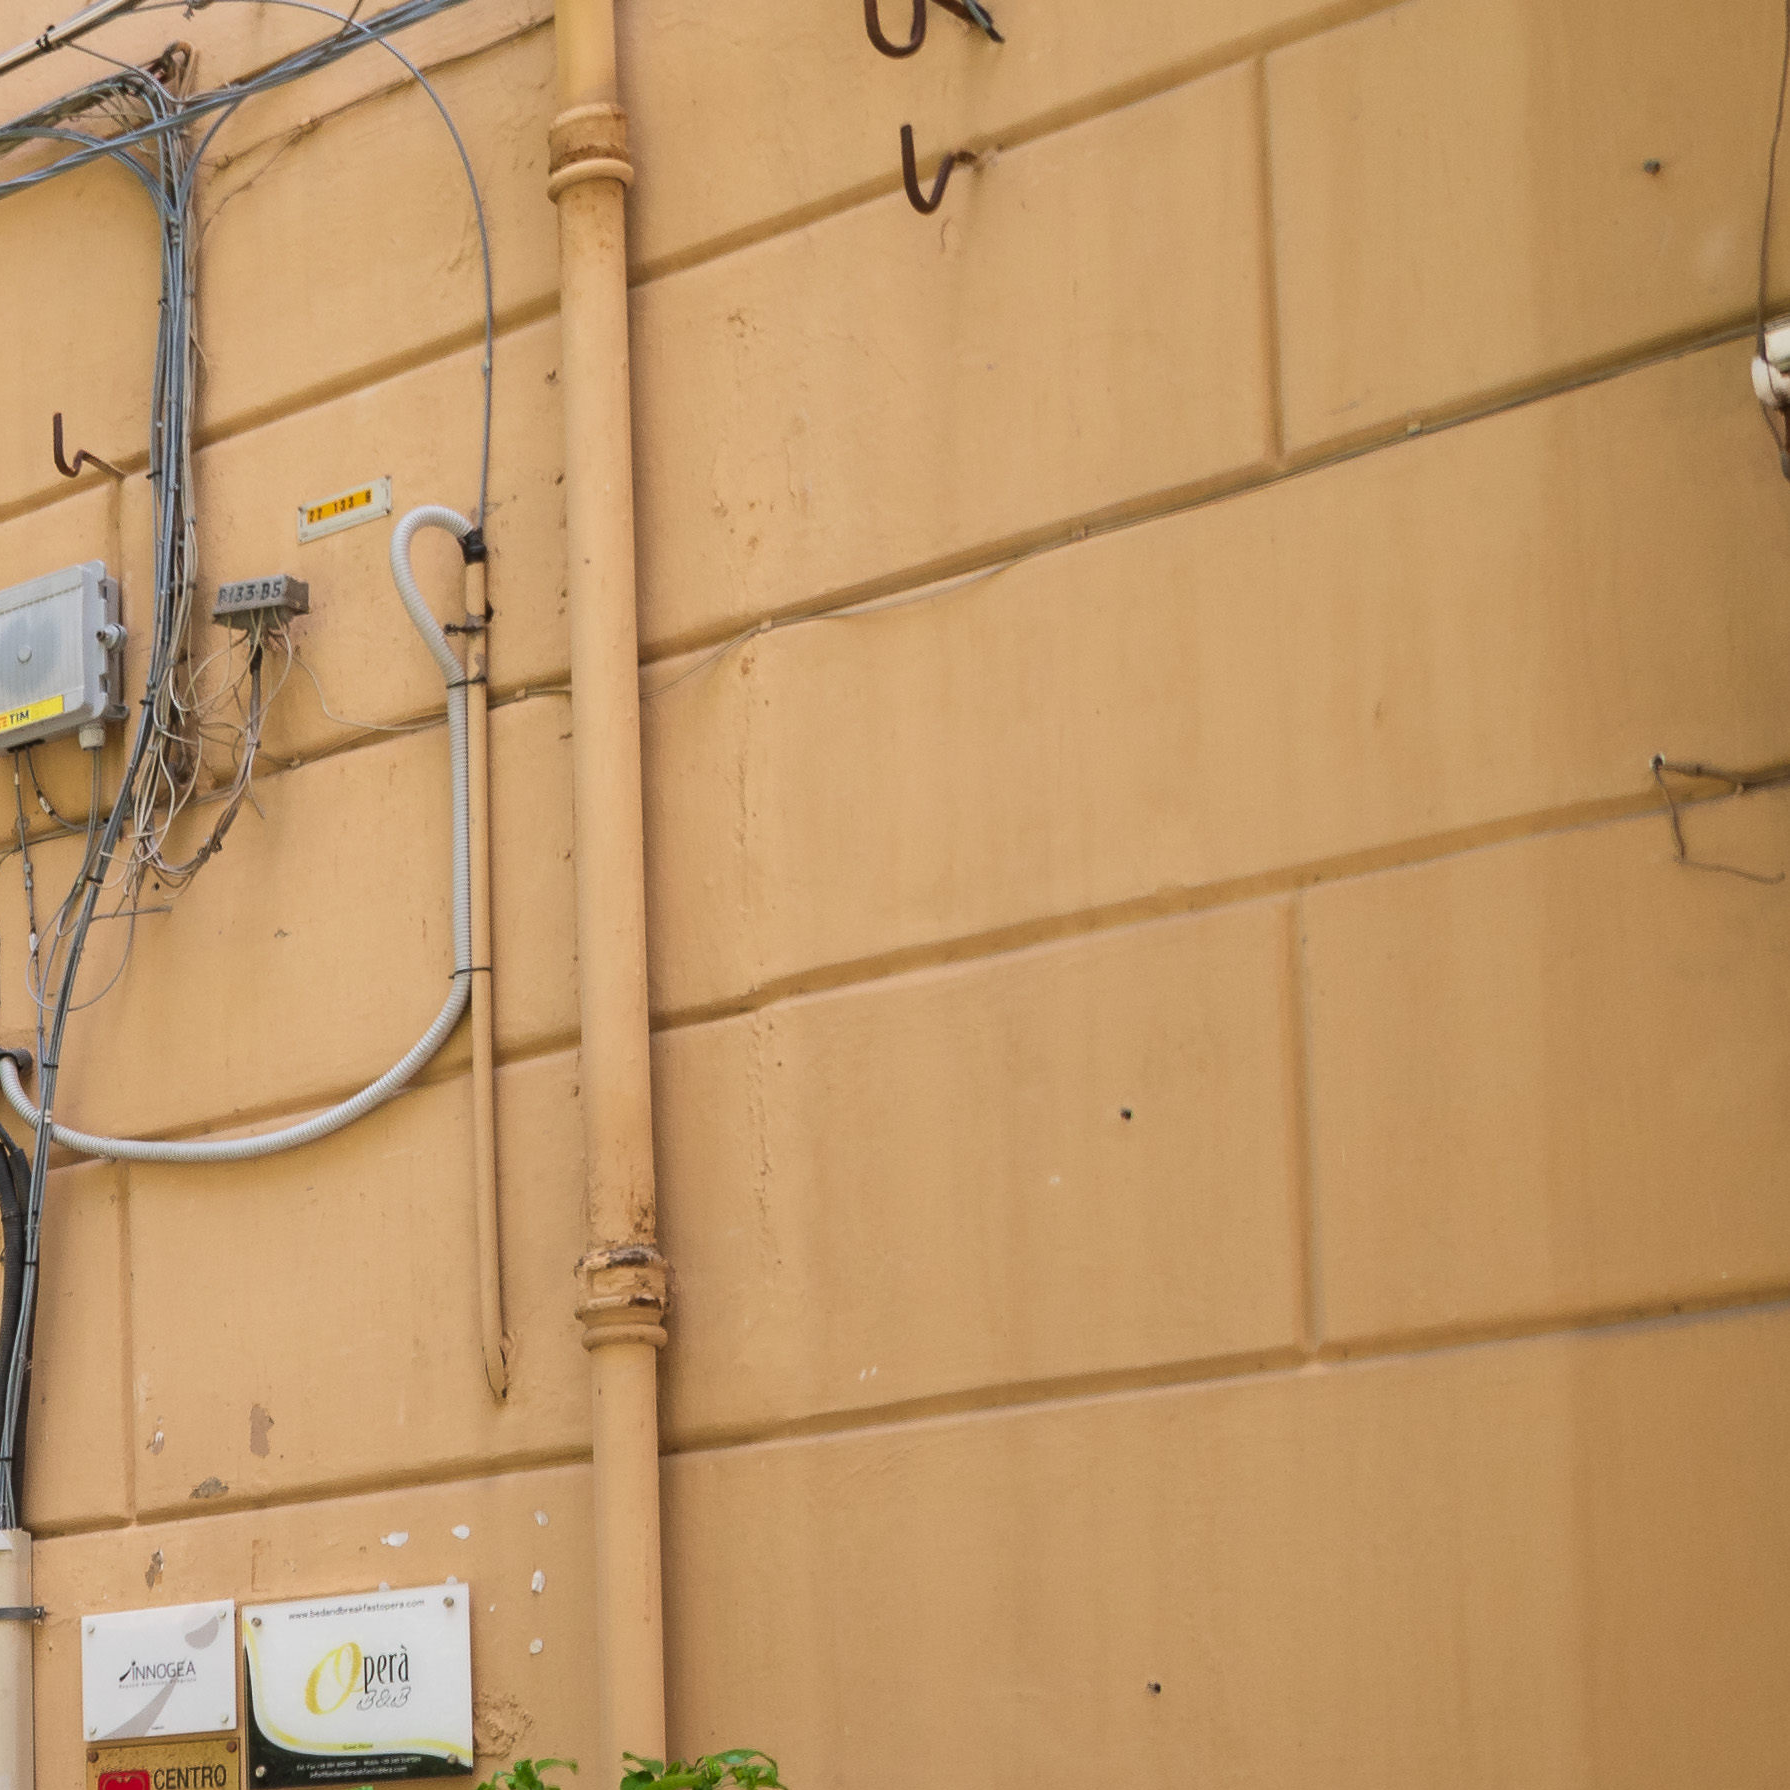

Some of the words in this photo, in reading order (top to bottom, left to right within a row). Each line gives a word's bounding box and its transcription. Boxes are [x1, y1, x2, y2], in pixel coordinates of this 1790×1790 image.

[9, 710, 30, 724] TIM
[288, 1599, 425, 1620] www.bedandbreakfastopera.com
[153, 1764, 227, 1790] CENTRO
